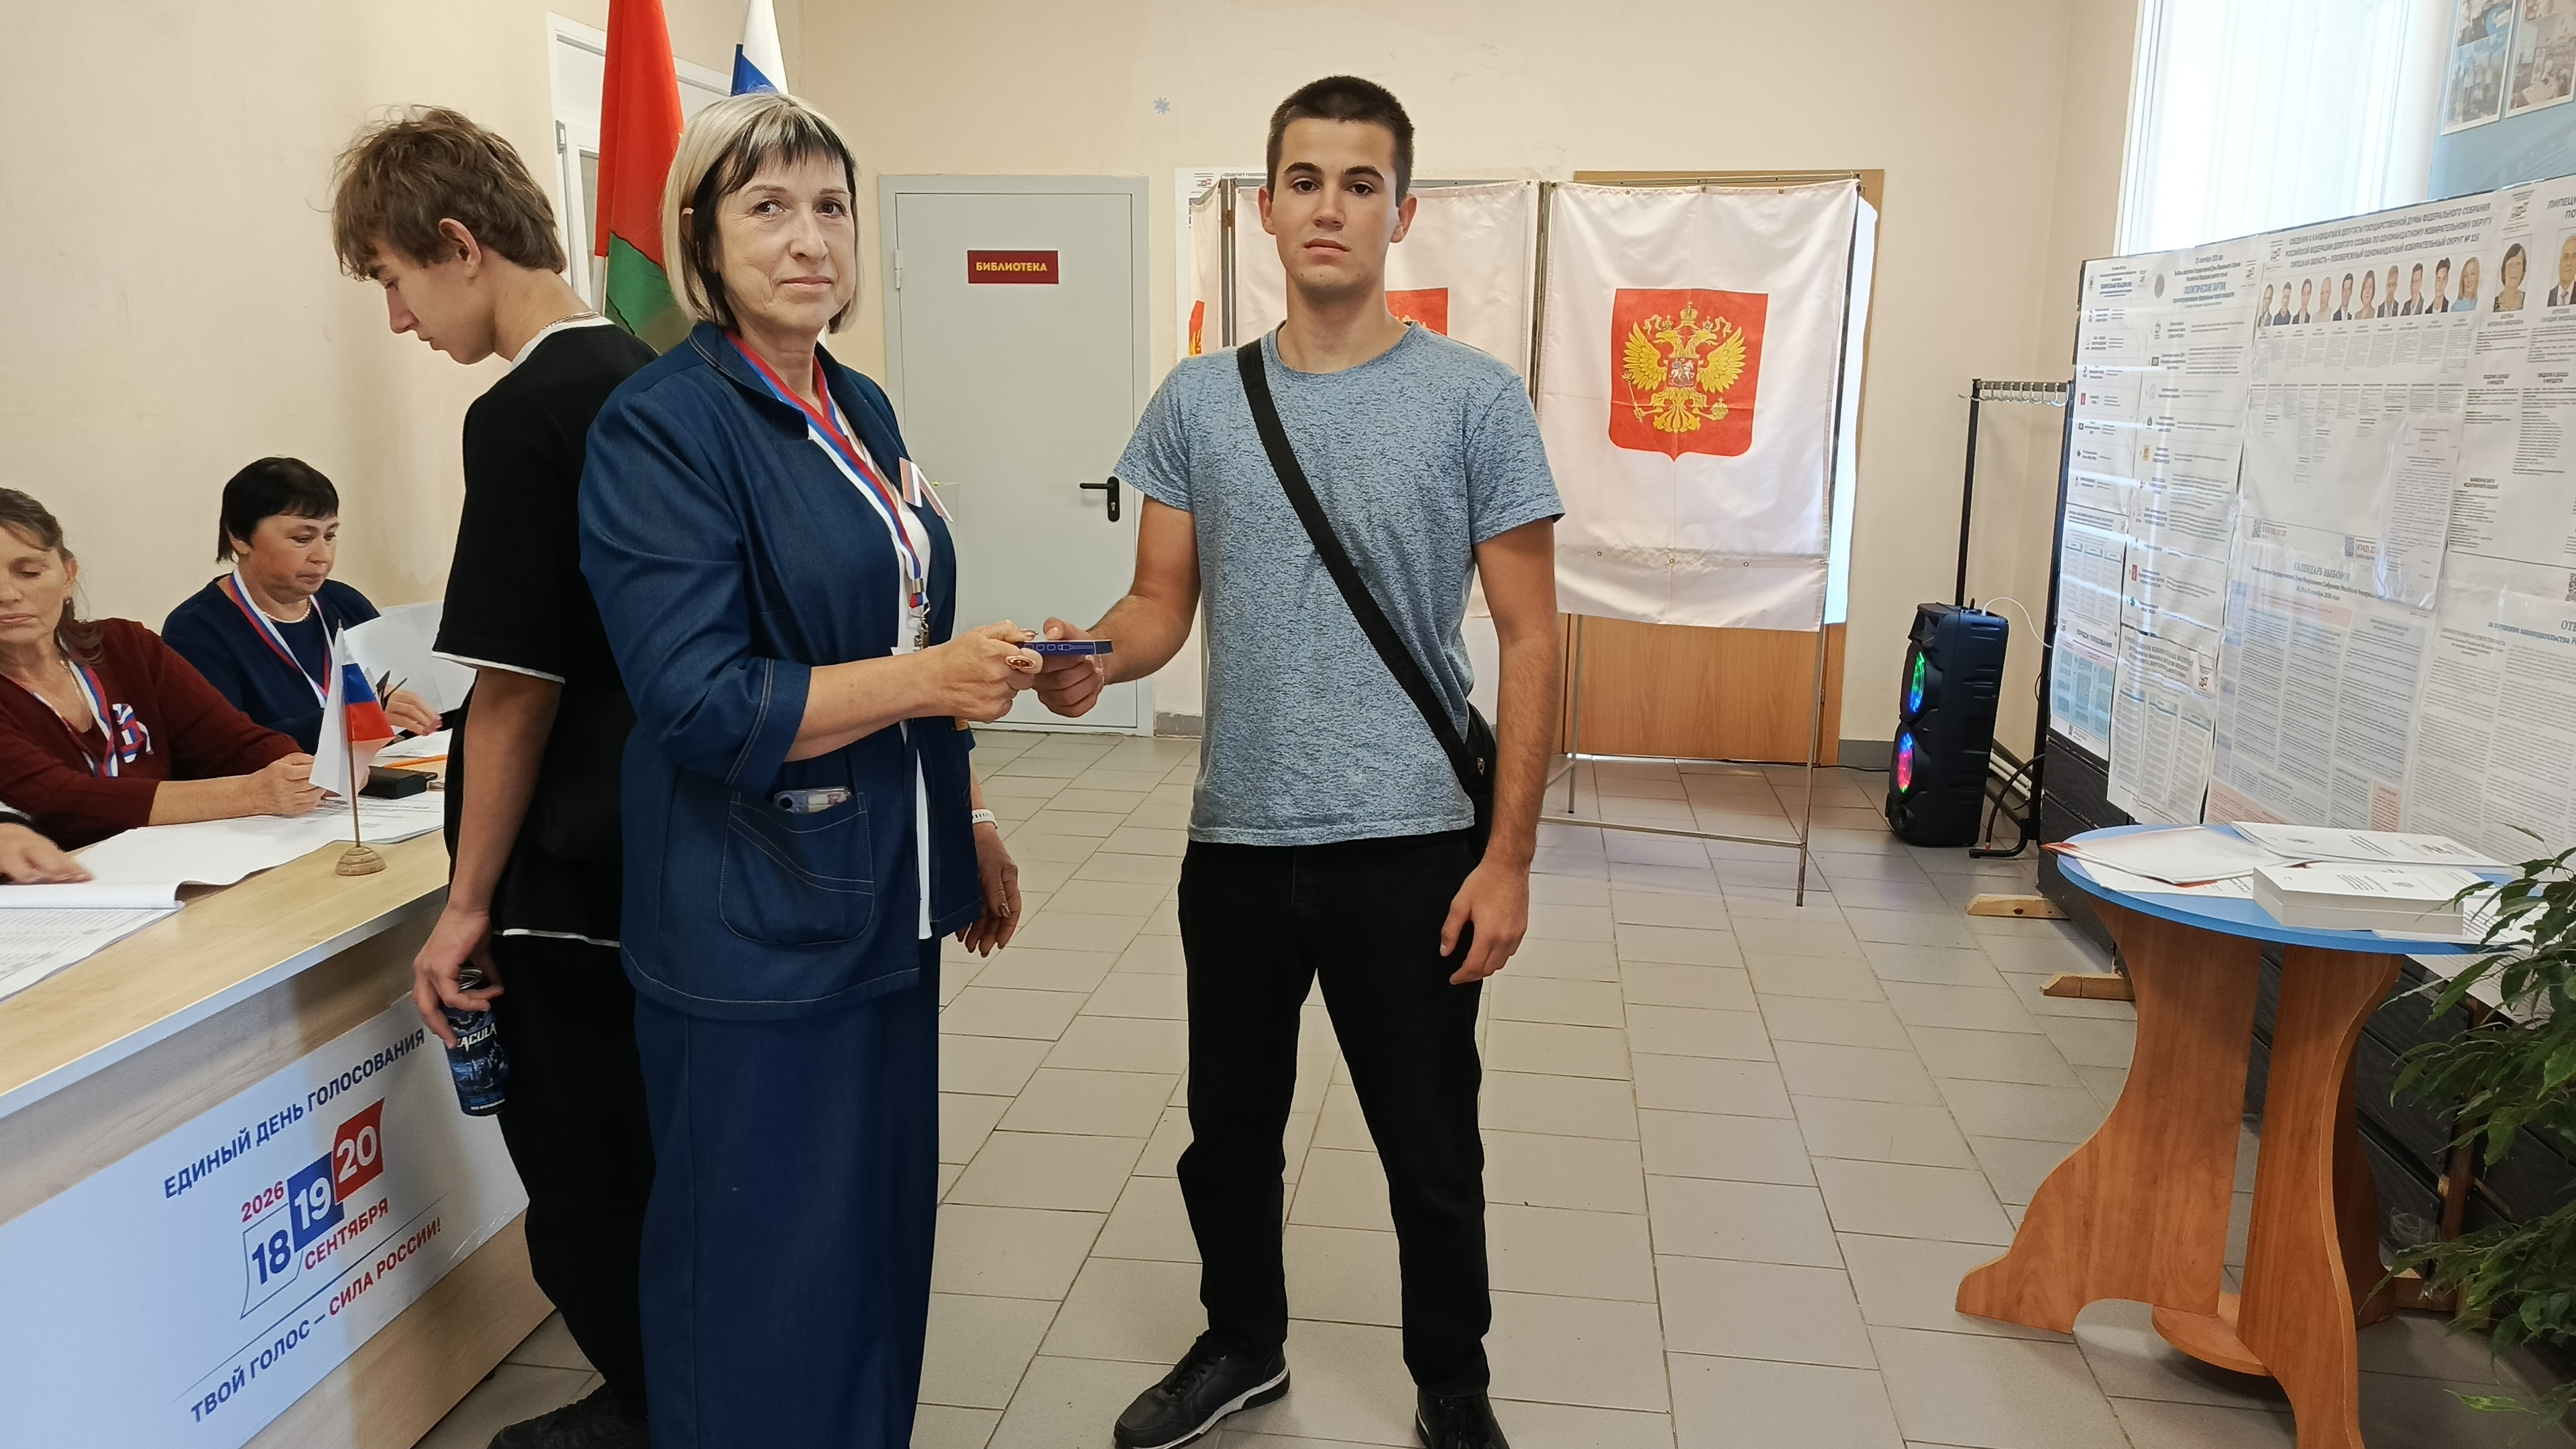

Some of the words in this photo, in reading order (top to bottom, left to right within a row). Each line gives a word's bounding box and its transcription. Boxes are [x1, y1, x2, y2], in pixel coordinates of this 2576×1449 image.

[975, 262, 1048, 272] БИБЛИОТЕКА
[457, 1022, 496, 1052] ACULA
[164, 1127, 251, 1199] ЕДИНЫЙ
[256, 1104, 304, 1146] ДЕНЬ
[308, 1028, 425, 1112] ГОЛОСОВАНИЯ
[241, 1181, 284, 1222] 2026
[252, 1230, 290, 1285] 18
[294, 1177, 331, 1230] 19
[337, 1125, 377, 1183] 20
[305, 1197, 388, 1270] СЕНТЯБРЯ
[191, 1365, 245, 1423] ТВОЙ
[250, 1320, 310, 1379] ГОЛОС
[329, 1271, 374, 1316] СИЛА
[376, 1217, 441, 1279] РОССИИ!
